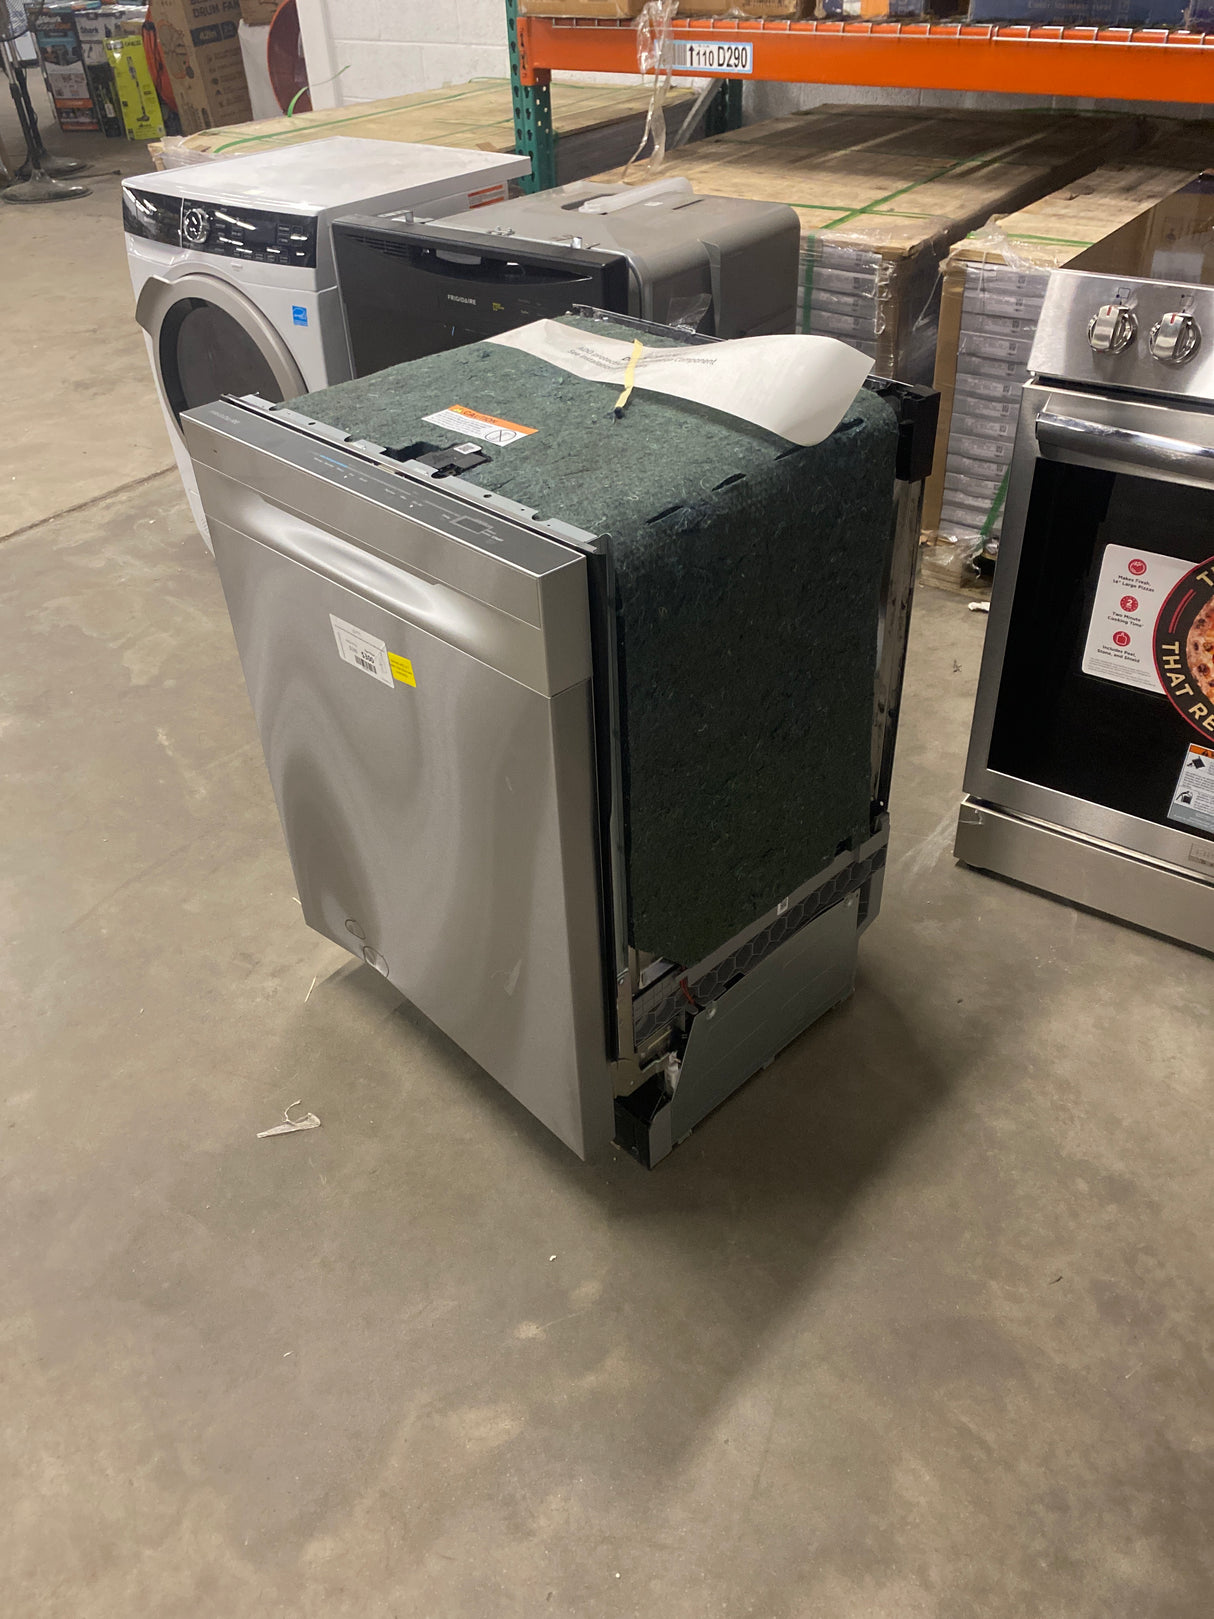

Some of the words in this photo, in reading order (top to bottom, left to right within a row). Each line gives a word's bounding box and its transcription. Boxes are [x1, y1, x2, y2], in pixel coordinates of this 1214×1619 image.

[192, 3, 220, 18] DRUM
[79, 25, 99, 34] Shark
[696, 50, 714, 67] 110
[717, 46, 748, 69] D290
[447, 294, 477, 306] FRIGIDAIRE
[463, 410, 496, 424] CAUTION
[1135, 579, 1151, 587] Fresh,
[1138, 585, 1155, 593] Pizzas
[1107, 615, 1128, 625] Cooking
[1124, 614, 1141, 622] Minute
[1102, 645, 1123, 654] Includes
[1097, 648, 1113, 657] Stone,
[1124, 655, 1140, 663] Shield
[1162, 642, 1194, 696] THAT
